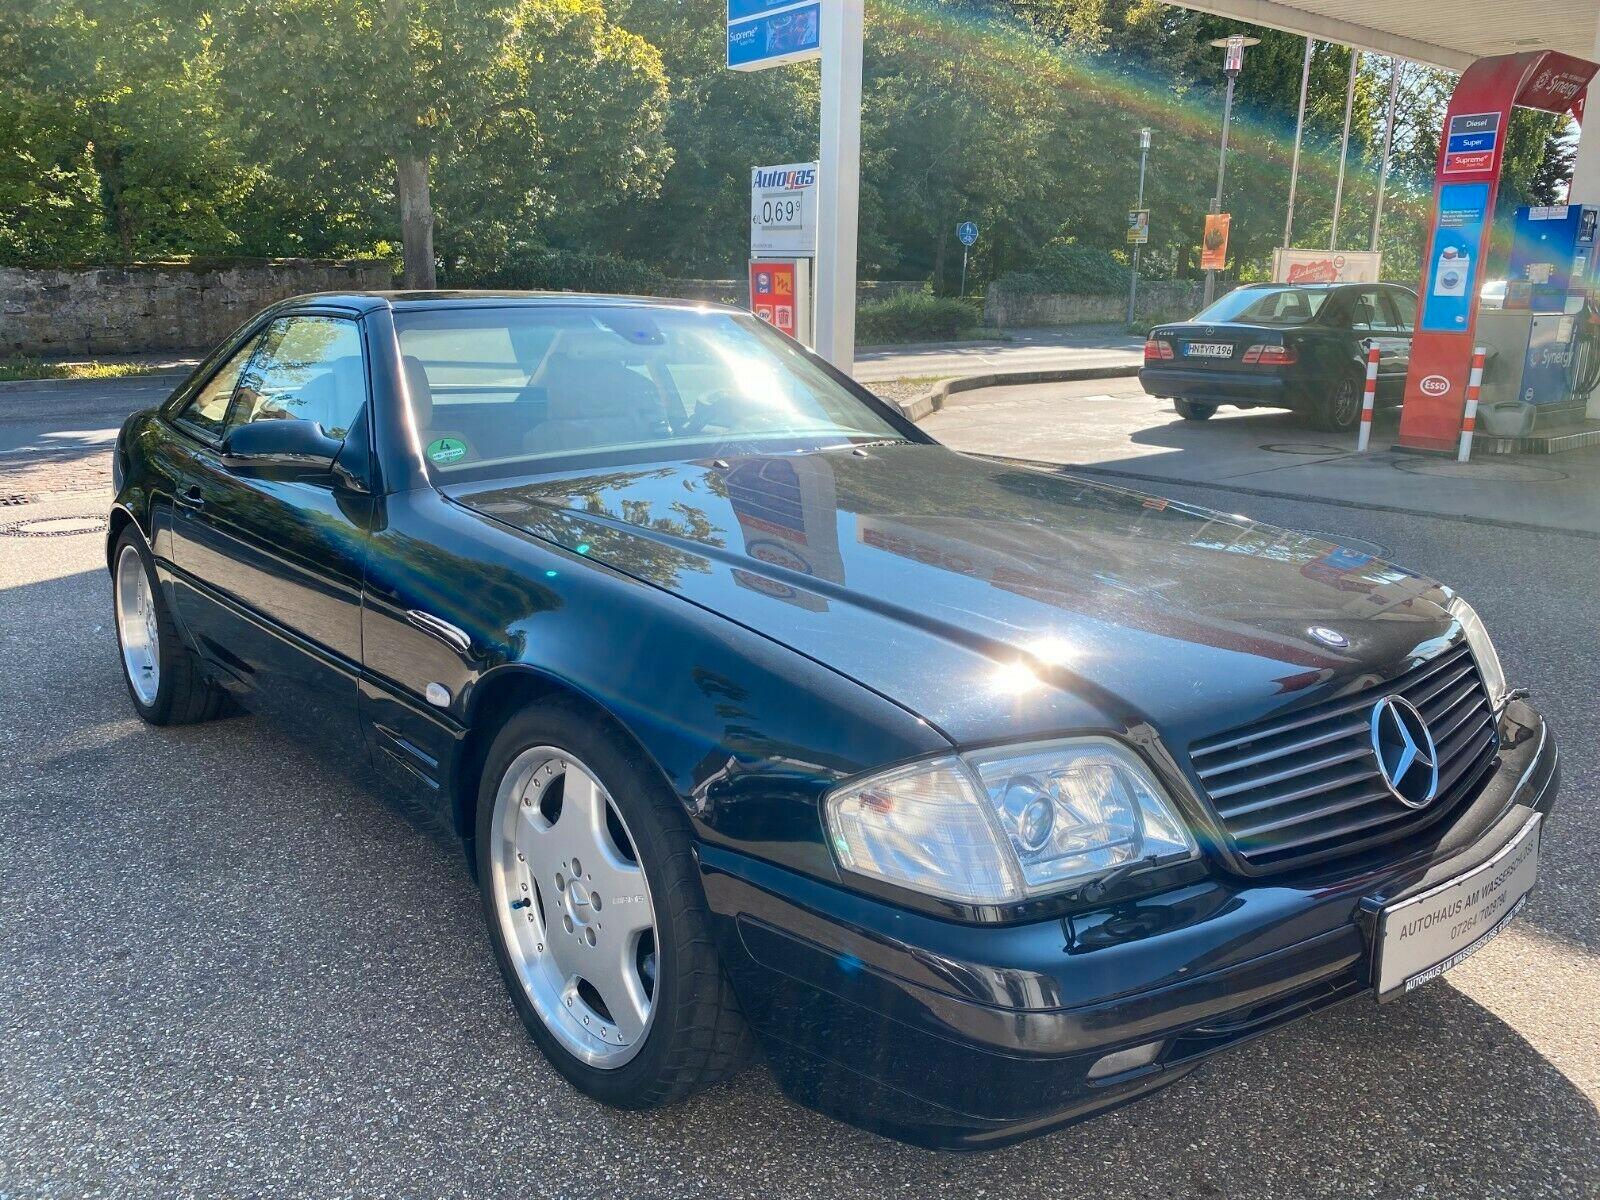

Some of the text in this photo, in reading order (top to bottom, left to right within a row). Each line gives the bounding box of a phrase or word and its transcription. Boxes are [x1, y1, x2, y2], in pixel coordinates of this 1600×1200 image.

[1545, 74, 1580, 100] Synergy
[1466, 118, 1488, 128] Diesel
[1462, 139, 1484, 148] Super
[752, 169, 816, 191] Autogas
[1188, 343, 1232, 356] HN YR 196
[1540, 348, 1574, 368] Synergy
[1424, 380, 1446, 391] Esso
[440, 440, 451, 450] 4
[1399, 899, 1463, 941] AUTOHAUS
[1464, 889, 1480, 910] AM
[1450, 913, 1478, 940] 07264
[1405, 967, 1442, 993] AUTOHAUS
